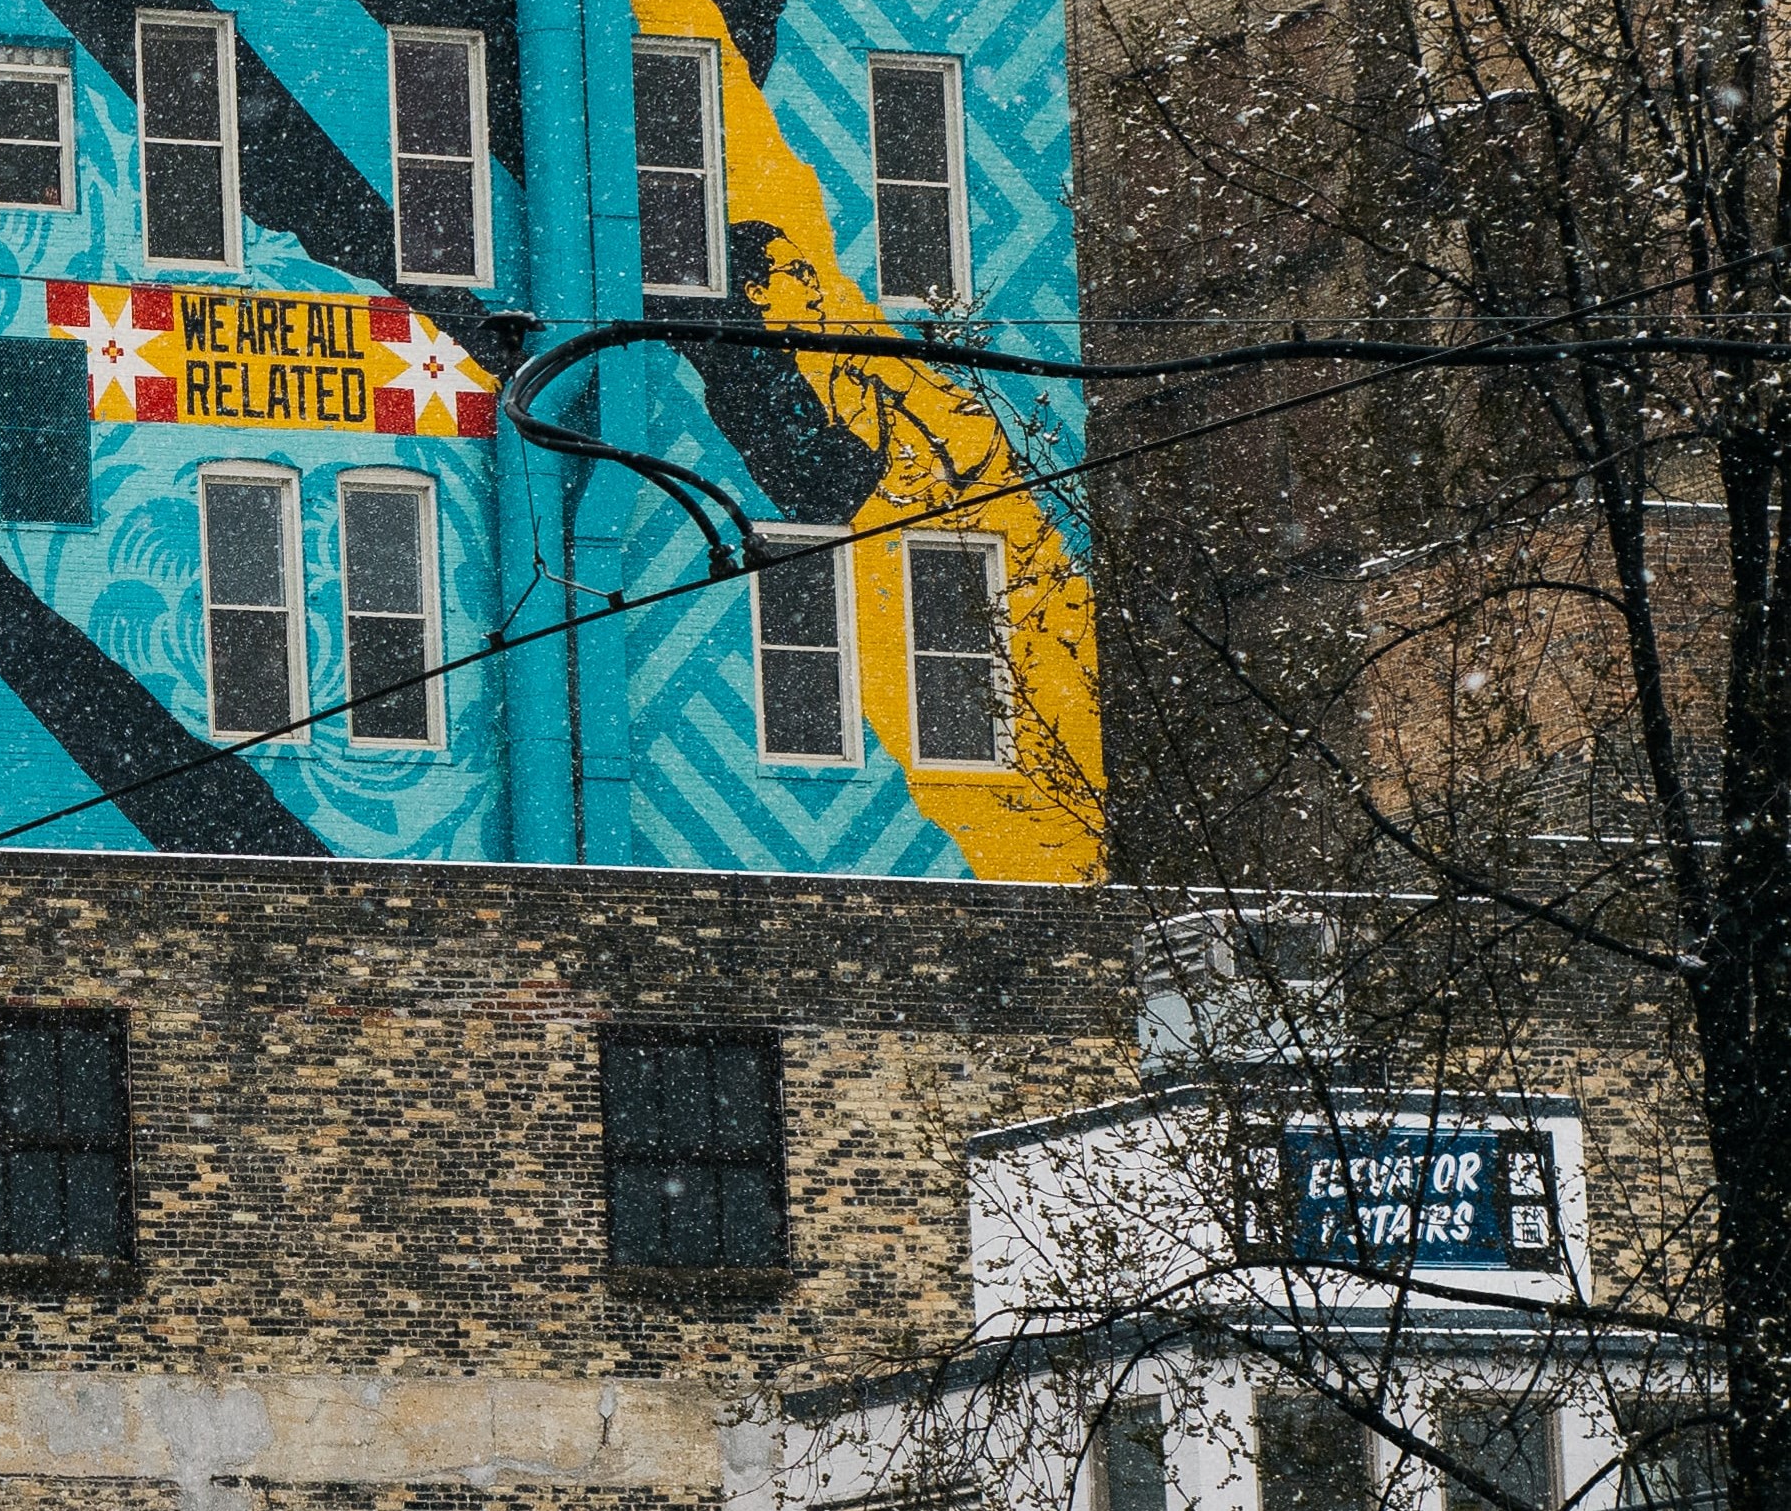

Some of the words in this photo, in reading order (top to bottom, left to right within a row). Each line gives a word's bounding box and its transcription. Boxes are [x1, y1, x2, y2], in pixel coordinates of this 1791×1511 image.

[180, 295, 231, 353] WE
[236, 299, 297, 358] ARE
[306, 302, 365, 359] ALL
[185, 359, 367, 424] RELATED
